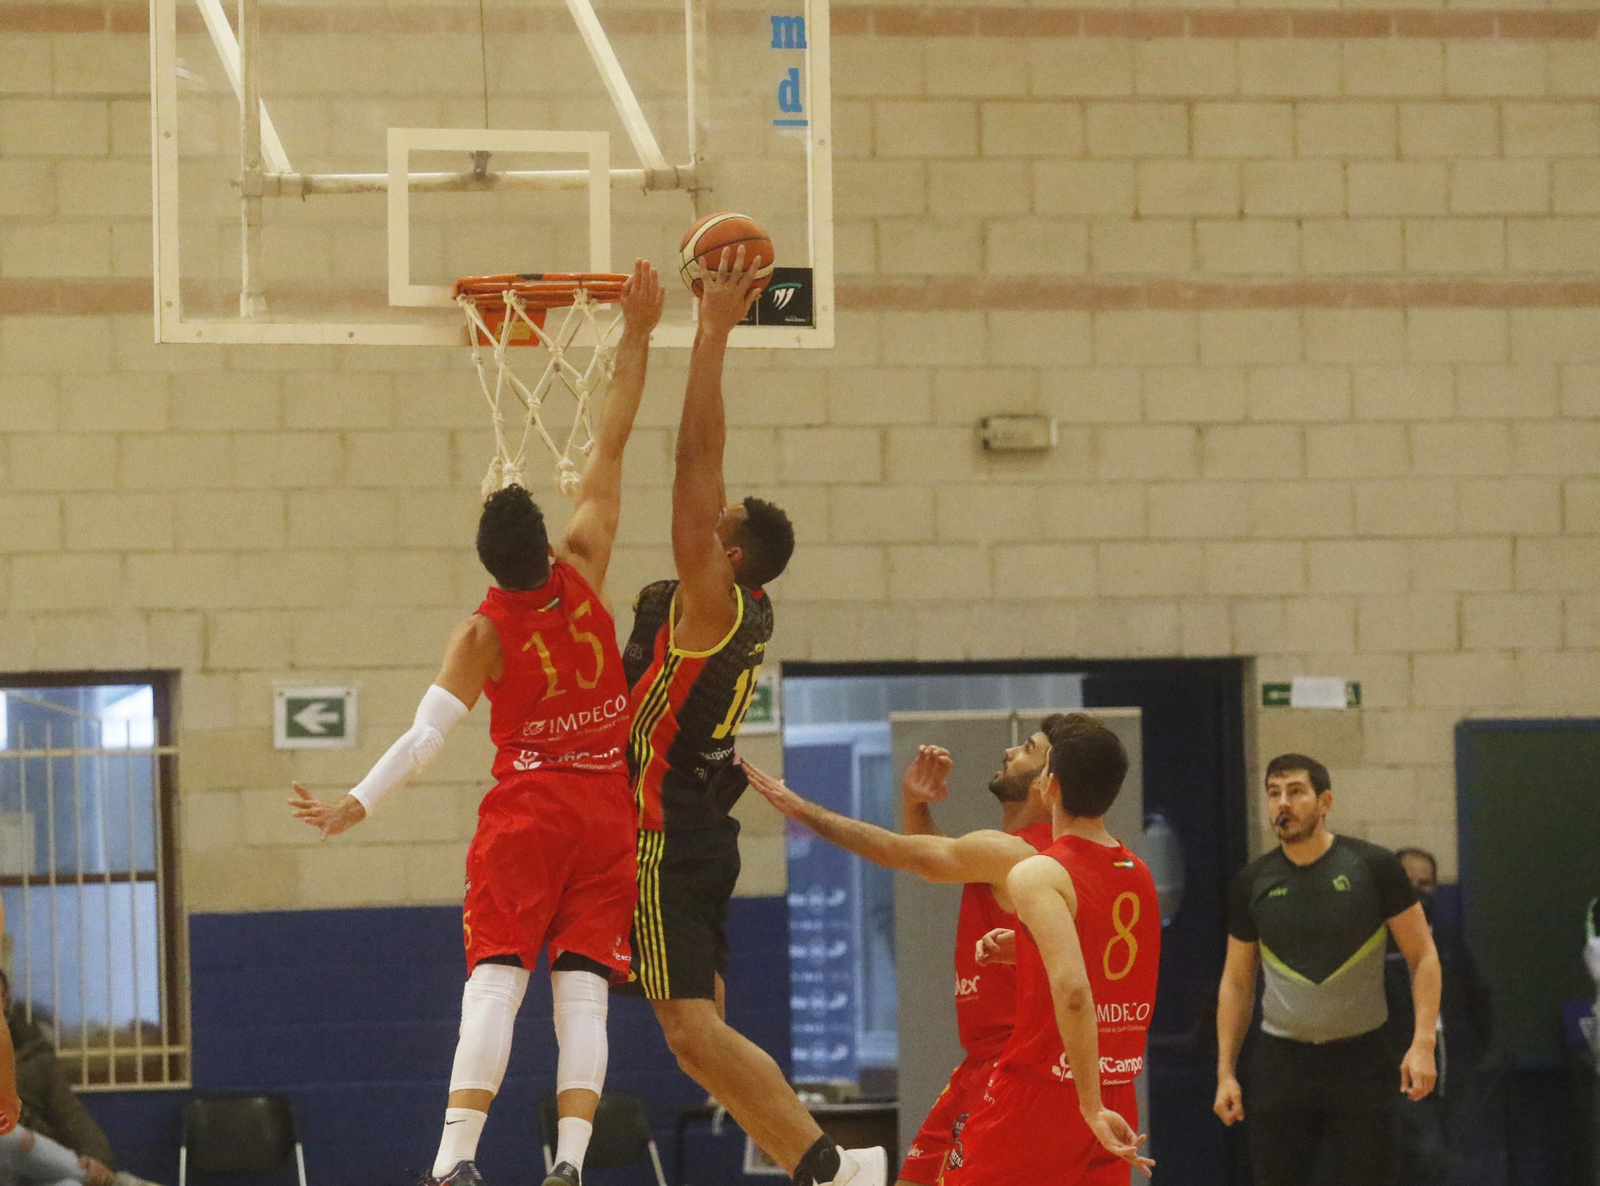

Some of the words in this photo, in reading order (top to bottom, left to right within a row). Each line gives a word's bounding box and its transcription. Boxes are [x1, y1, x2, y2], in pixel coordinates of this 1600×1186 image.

[521, 599, 605, 702] 15
[548, 694, 627, 734] IMDECO
[1103, 891, 1140, 981] 8
[1096, 1002, 1150, 1022] MDECO
